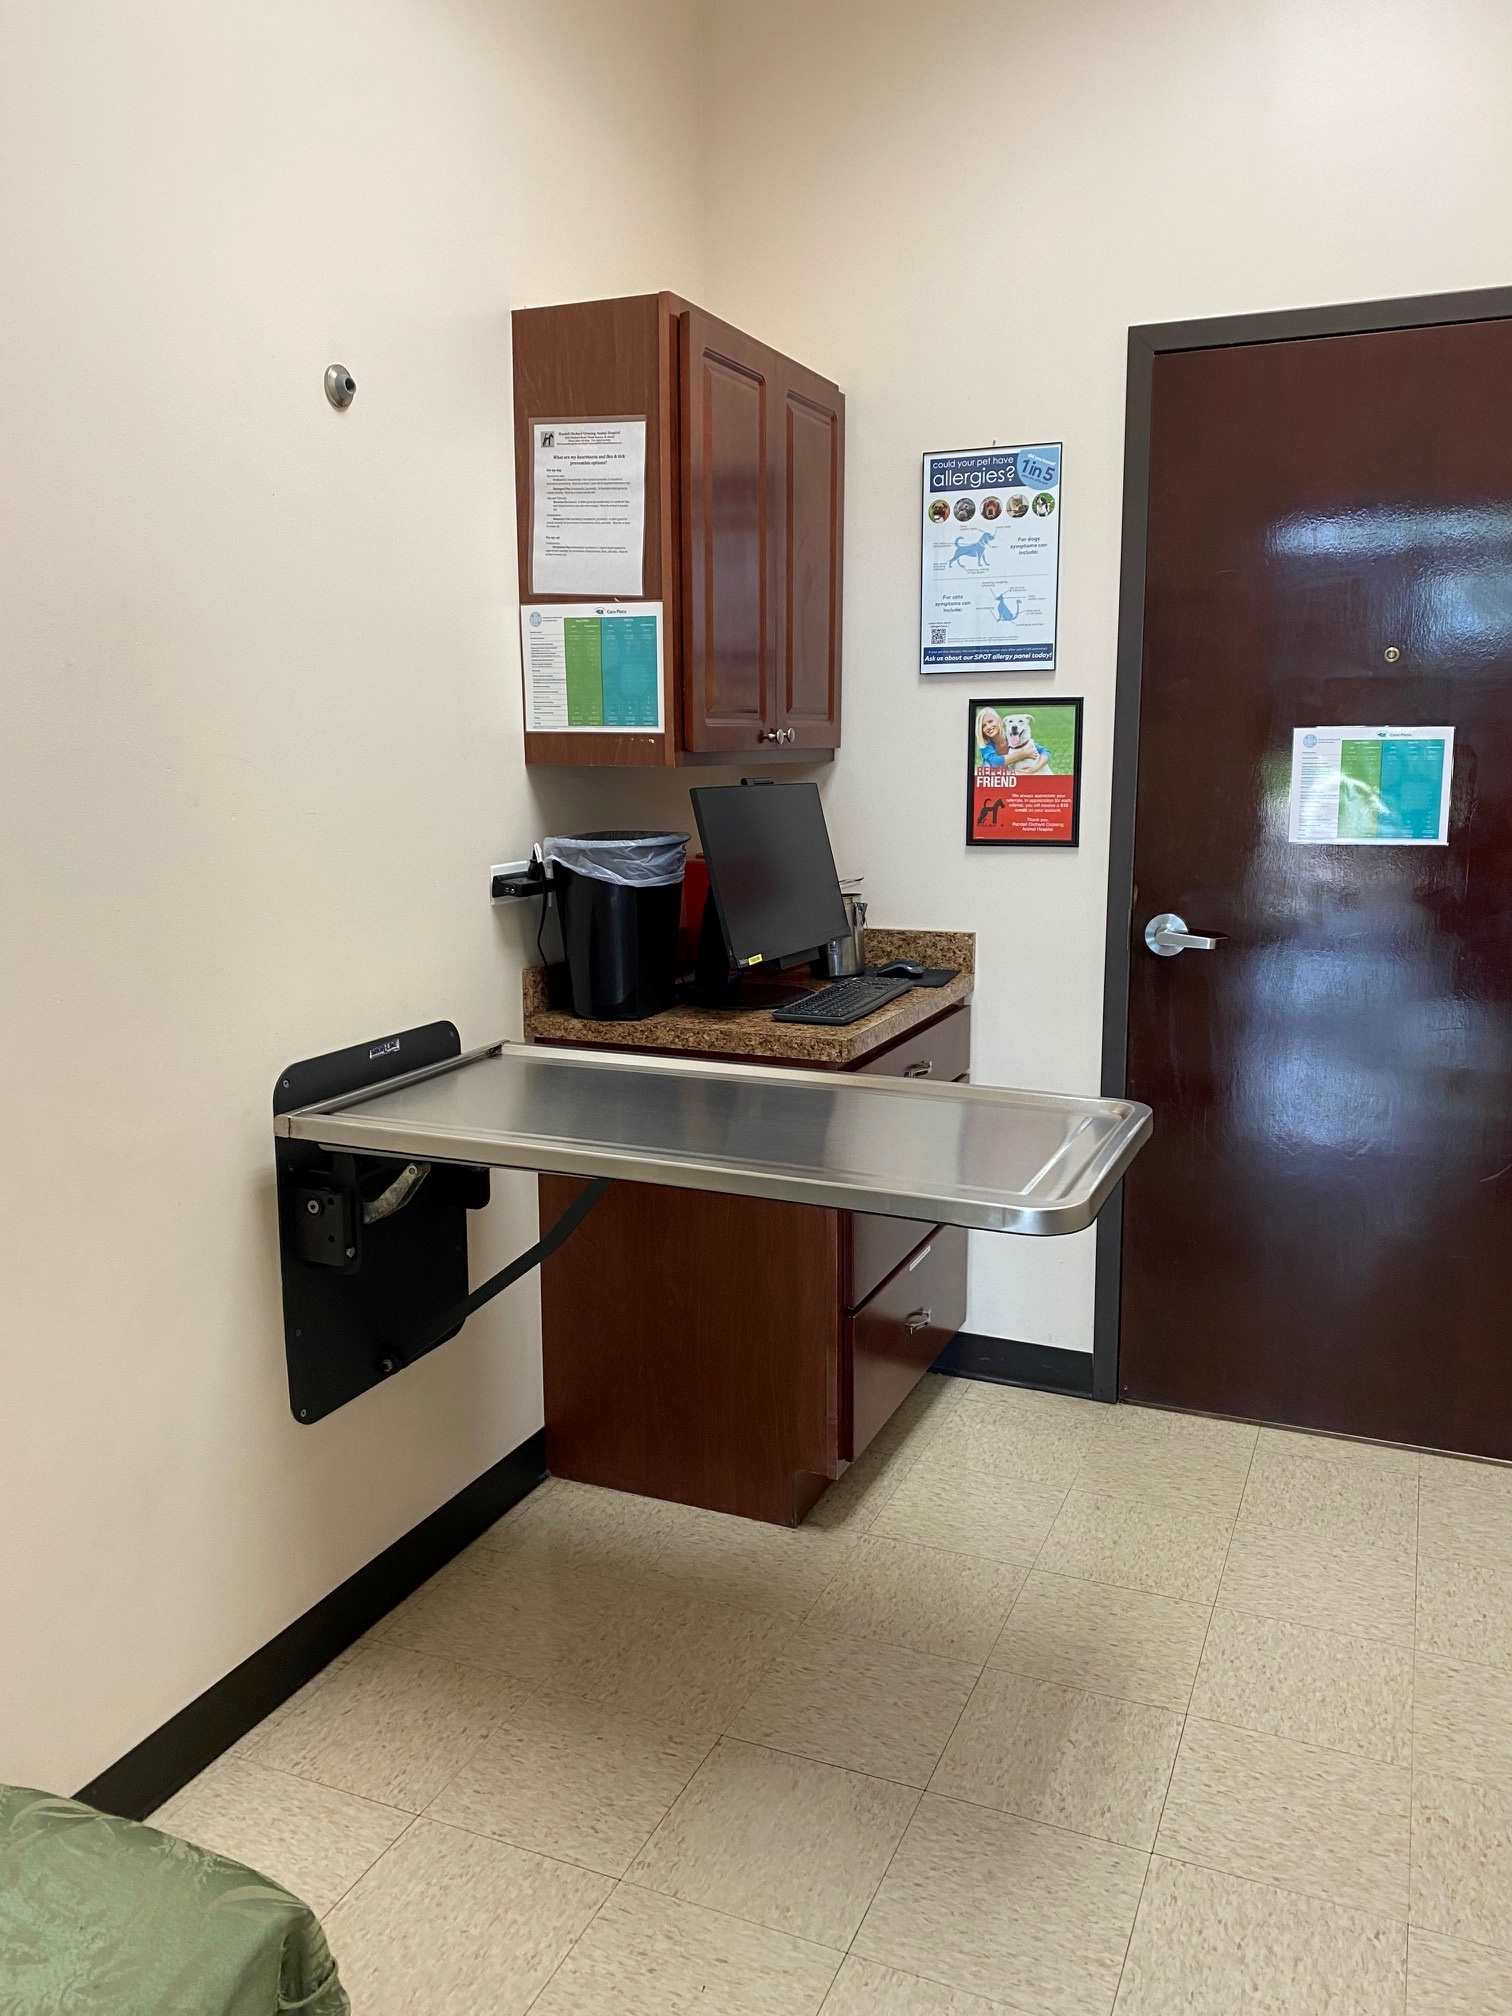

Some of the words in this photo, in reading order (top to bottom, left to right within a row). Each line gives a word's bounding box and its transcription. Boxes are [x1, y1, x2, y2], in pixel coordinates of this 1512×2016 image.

[932, 460, 955, 469] could
[957, 459, 975, 469] your
[977, 458, 991, 467] pet
[993, 456, 1014, 465] have
[1023, 459, 1030, 473] 1
[1028, 461, 1042, 478] in
[1043, 466, 1056, 481] 5
[933, 466, 1016, 488] allergies?
[992, 653, 1013, 661] allergy
[1013, 653, 1031, 661] panel
[976, 776, 1017, 788] FRIEND
